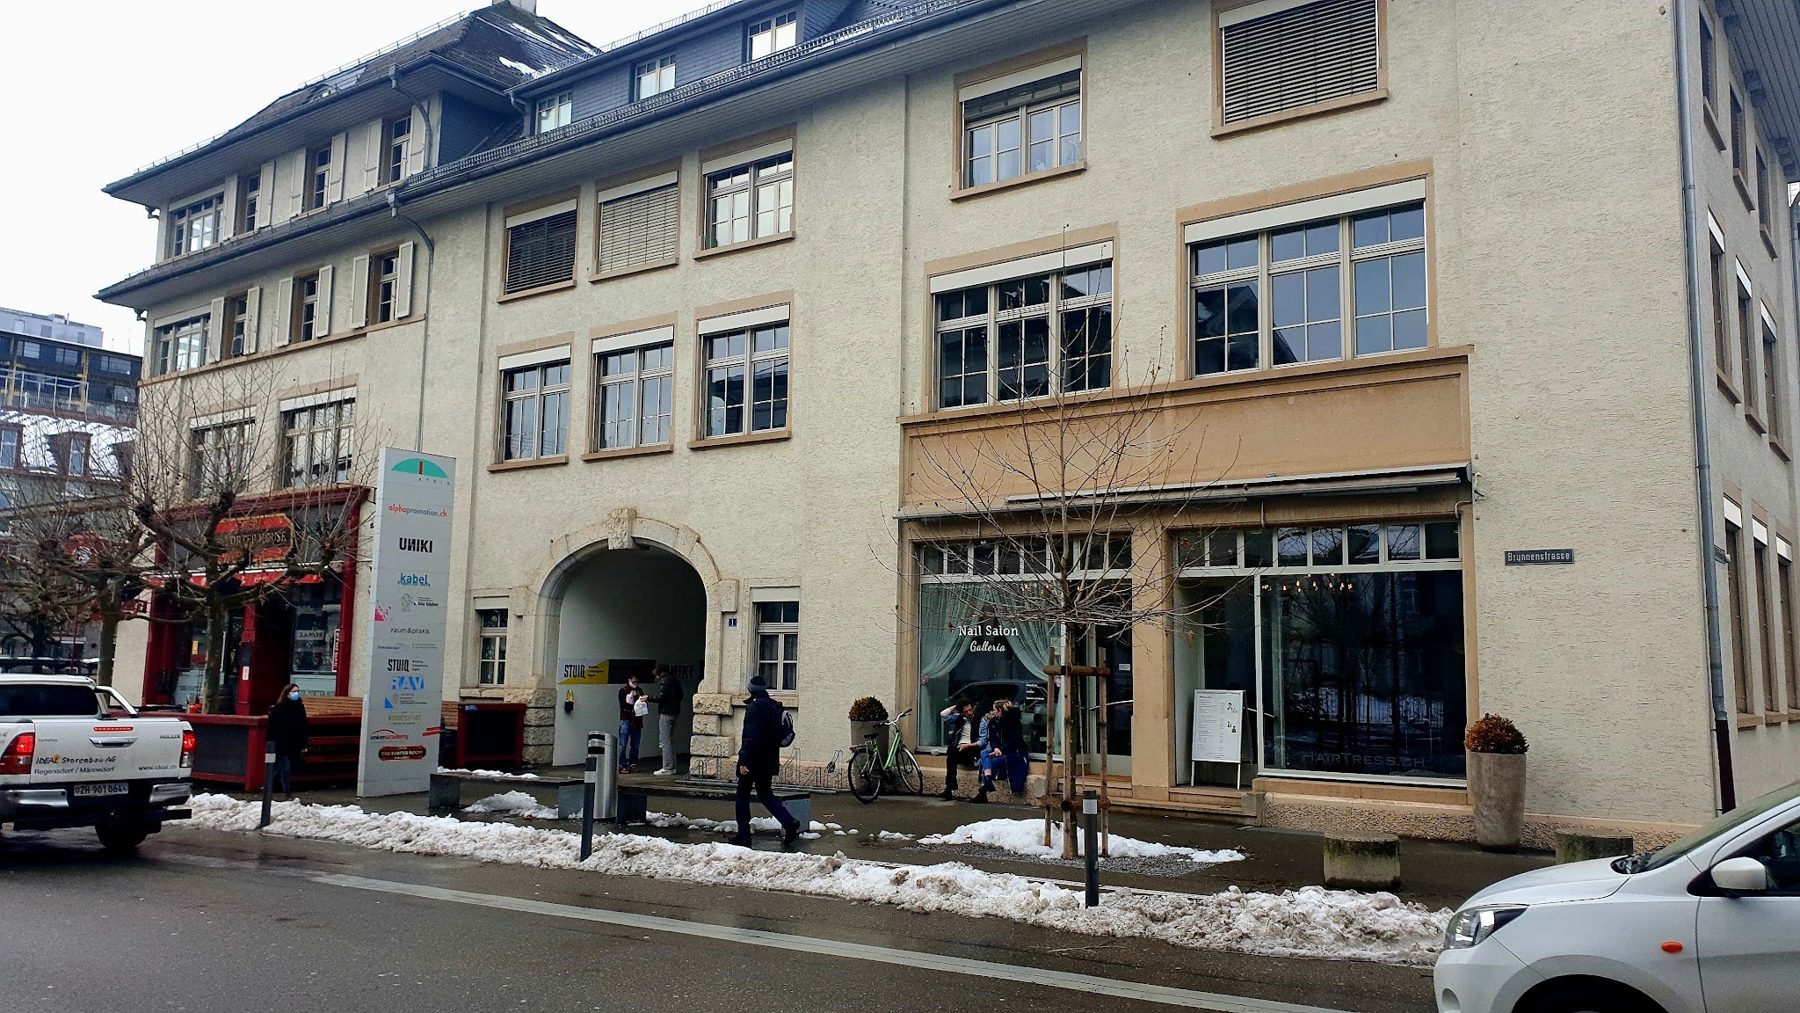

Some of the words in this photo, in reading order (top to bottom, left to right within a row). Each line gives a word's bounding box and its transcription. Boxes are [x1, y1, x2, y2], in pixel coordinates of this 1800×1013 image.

[388, 503, 448, 518] alphapromotion.ch
[1507, 551, 1570, 562] Brunnenstrasse
[958, 624, 982, 636] Nail
[985, 624, 1019, 636] Salon
[969, 640, 1006, 652] Galleria
[387, 658, 410, 672] STUIQ
[563, 664, 586, 679] STUIQ
